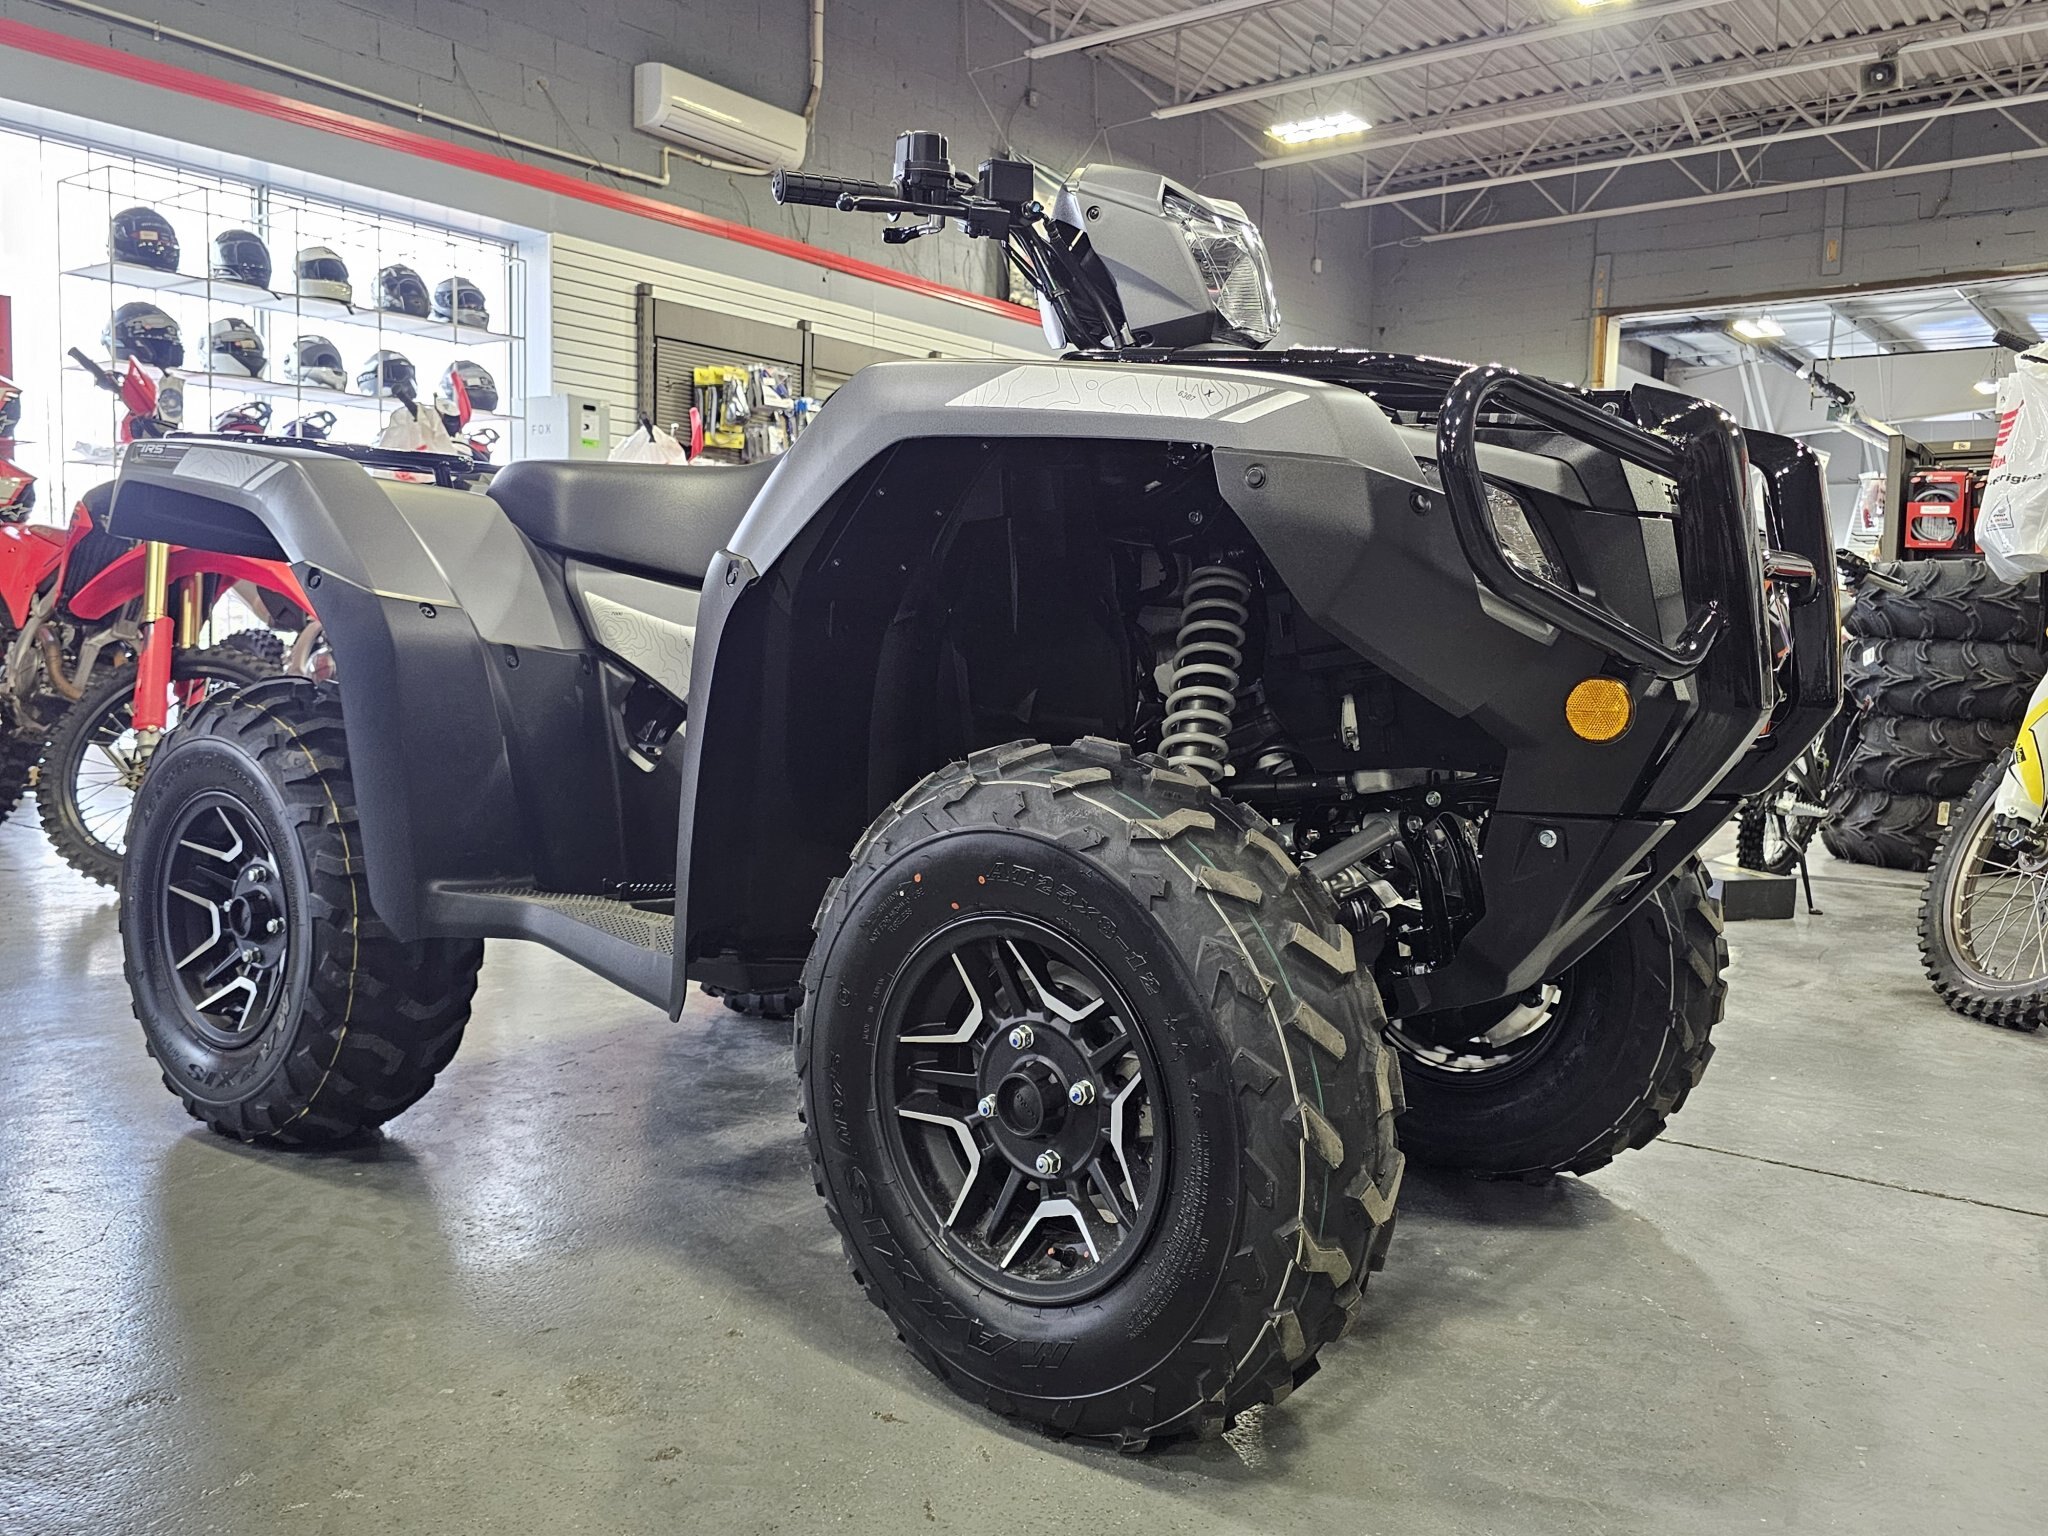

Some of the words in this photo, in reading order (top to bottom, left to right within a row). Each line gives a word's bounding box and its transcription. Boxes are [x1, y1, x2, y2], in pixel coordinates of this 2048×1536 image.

[531, 424, 552, 435] FOX
[139, 443, 166, 455] IRS
[845, 1165, 1079, 1369] MAXXIS
